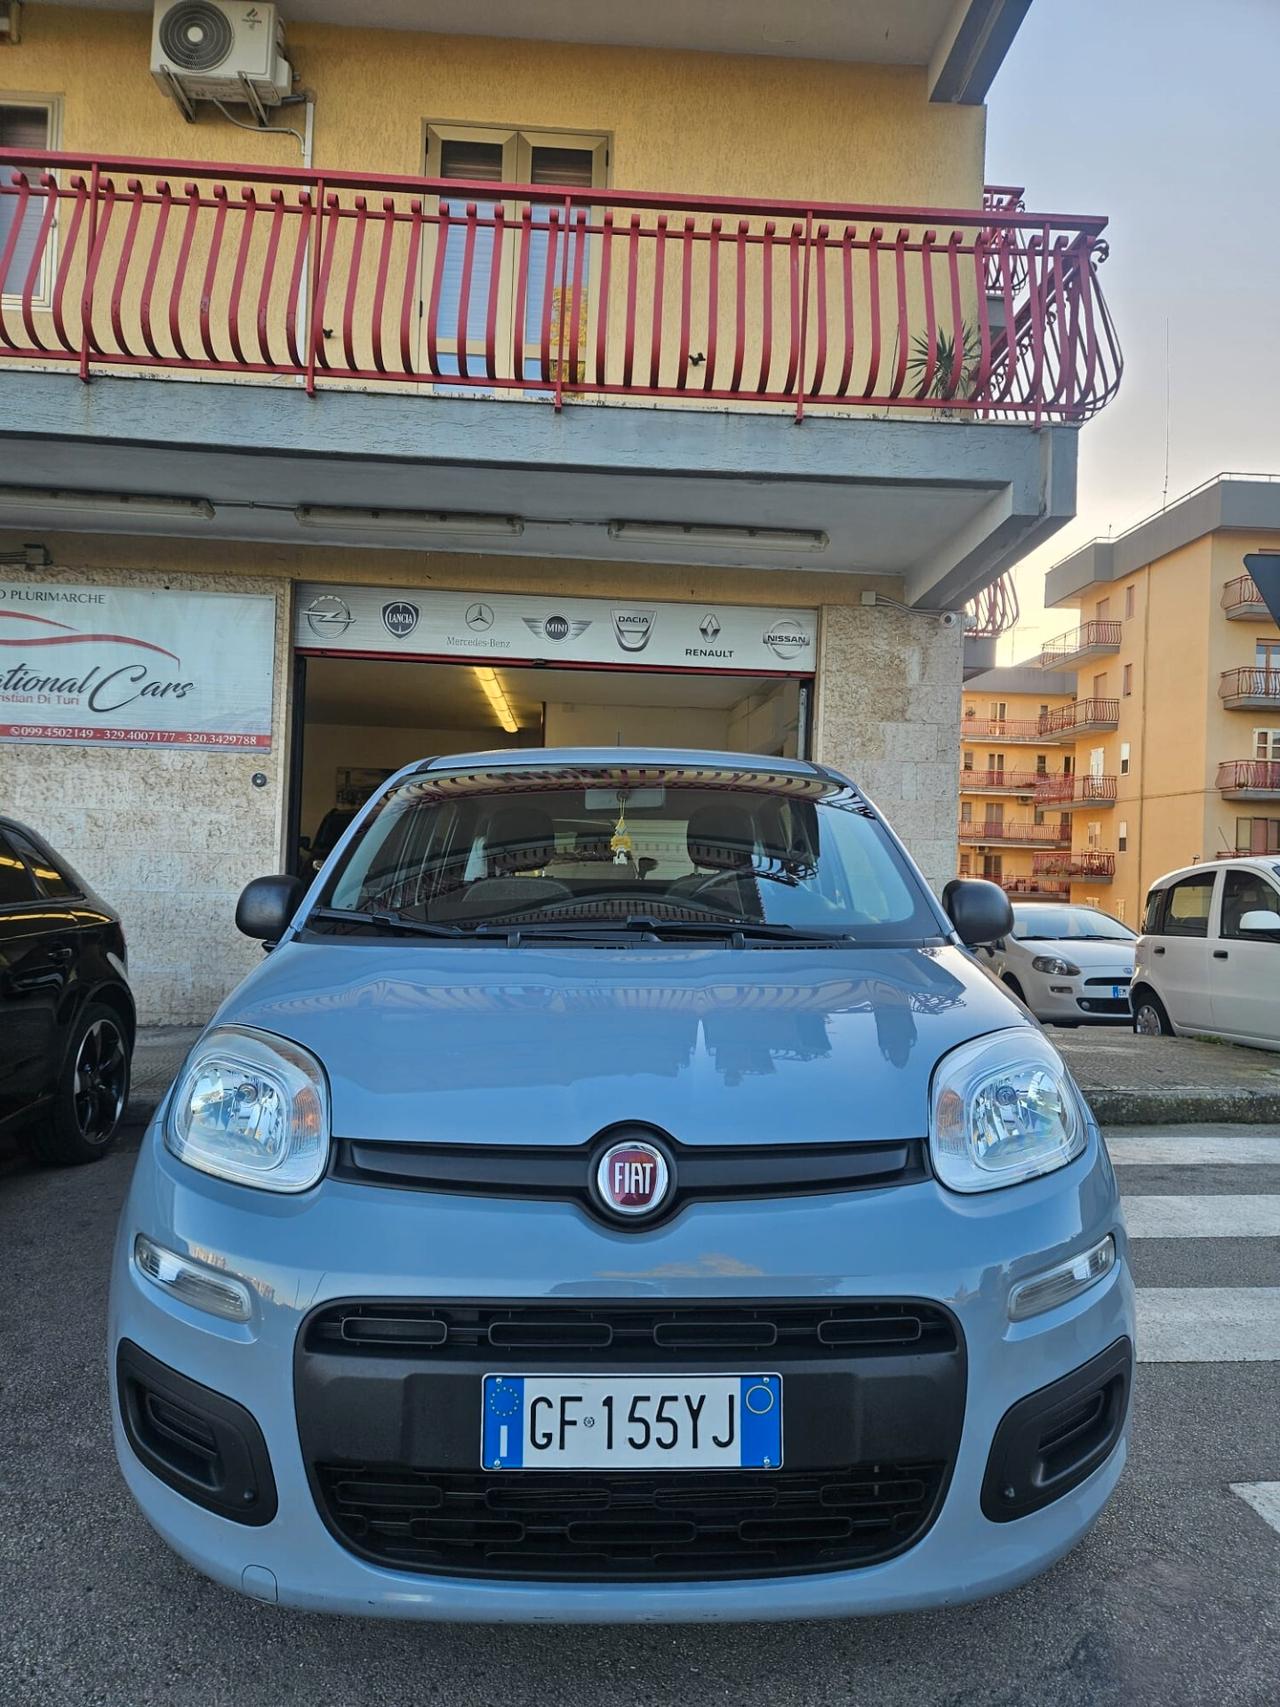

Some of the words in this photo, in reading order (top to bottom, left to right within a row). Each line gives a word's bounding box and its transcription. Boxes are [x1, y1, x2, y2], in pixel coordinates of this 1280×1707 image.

[10, 590, 106, 604] PLURIMARCHE
[388, 613, 413, 624] LANCIA
[618, 616, 648, 625] DACIA
[546, 623, 568, 633] MINI
[446, 637, 511, 649] Mercedes-Benz
[767, 634, 806, 643] NISSAN
[685, 648, 734, 658] RENAULT
[88, 664, 195, 713] Cars
[38, 694, 51, 704] Di
[57, 694, 80, 705] Turi
[21, 726, 94, 738] 099.4502149
[104, 730, 175, 742] 329.4007177
[186, 734, 257, 745] 320.3429788
[614, 1162, 654, 1194] FIAT
